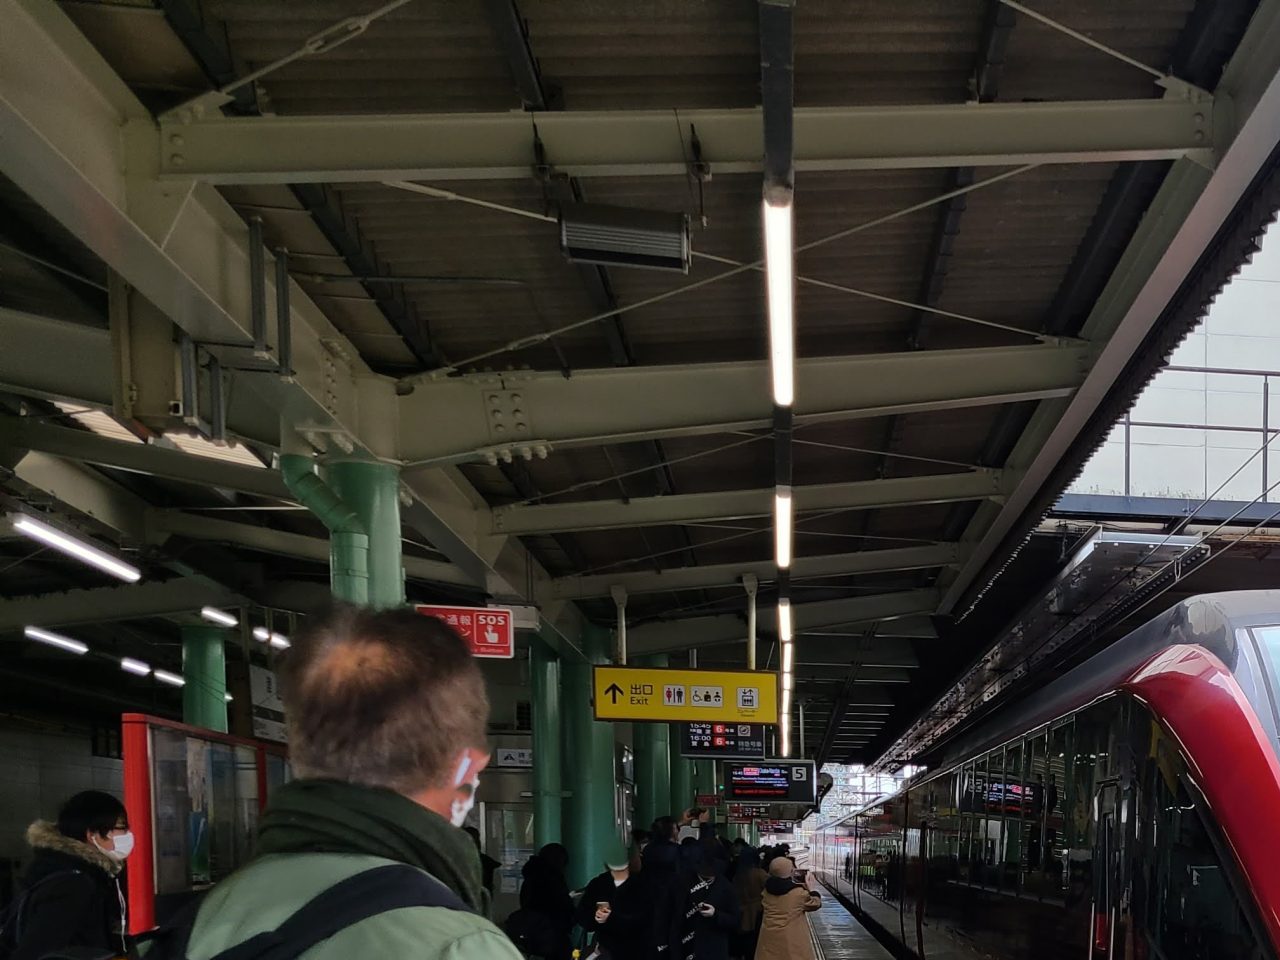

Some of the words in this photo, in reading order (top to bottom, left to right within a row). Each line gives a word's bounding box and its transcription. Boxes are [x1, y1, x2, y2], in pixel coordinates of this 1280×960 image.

[478, 615, 505, 625] SOS
[630, 684, 653, 695] 出口
[630, 696, 648, 705] Exit
[794, 768, 804, 779] 5
